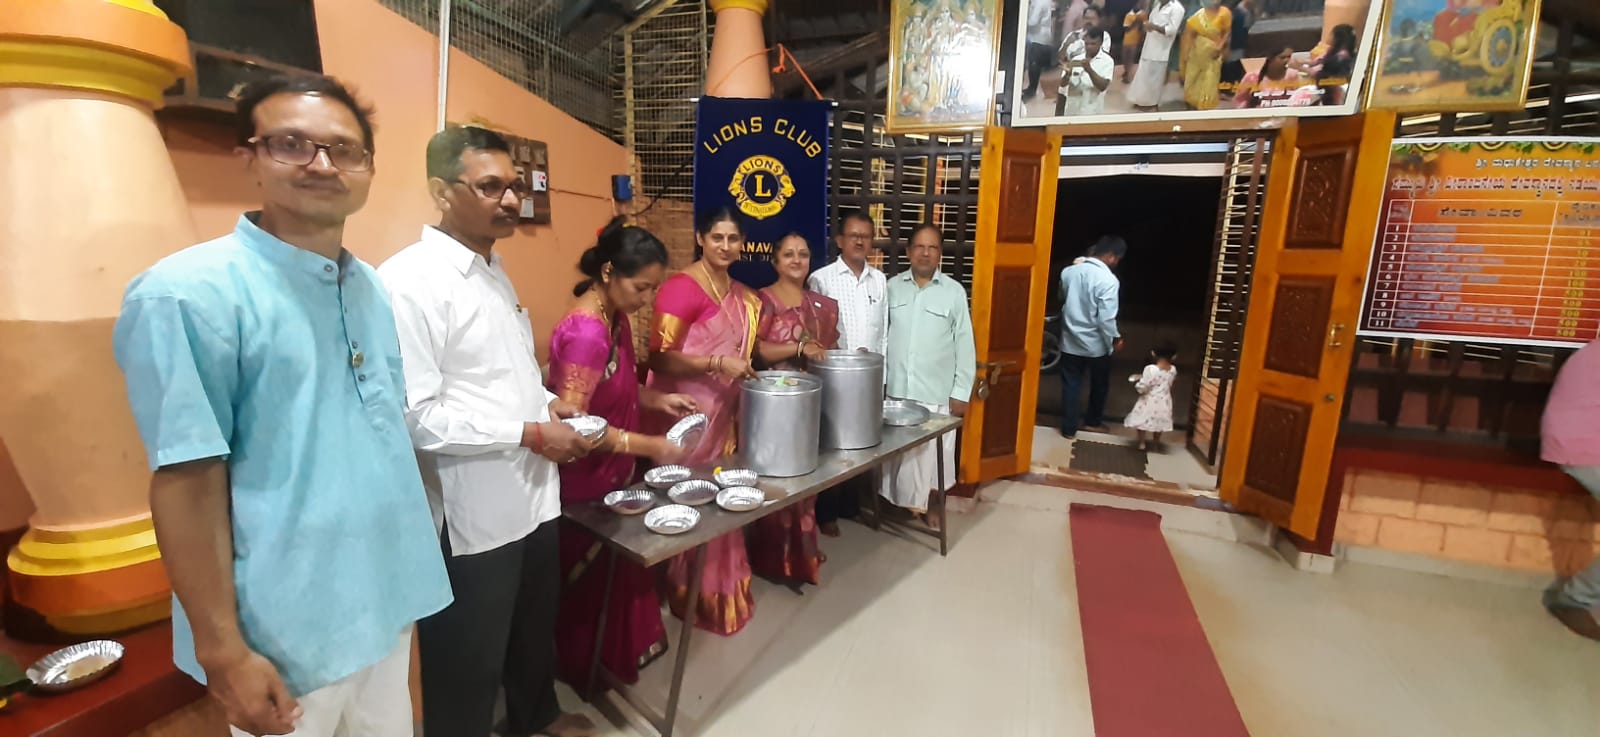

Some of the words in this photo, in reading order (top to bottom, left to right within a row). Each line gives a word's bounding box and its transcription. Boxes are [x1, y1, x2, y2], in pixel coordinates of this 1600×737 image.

[703, 116, 763, 154] LIONS
[774, 118, 822, 158] CLUB
[744, 158, 782, 174] LIONS
[754, 174, 771, 197] L
